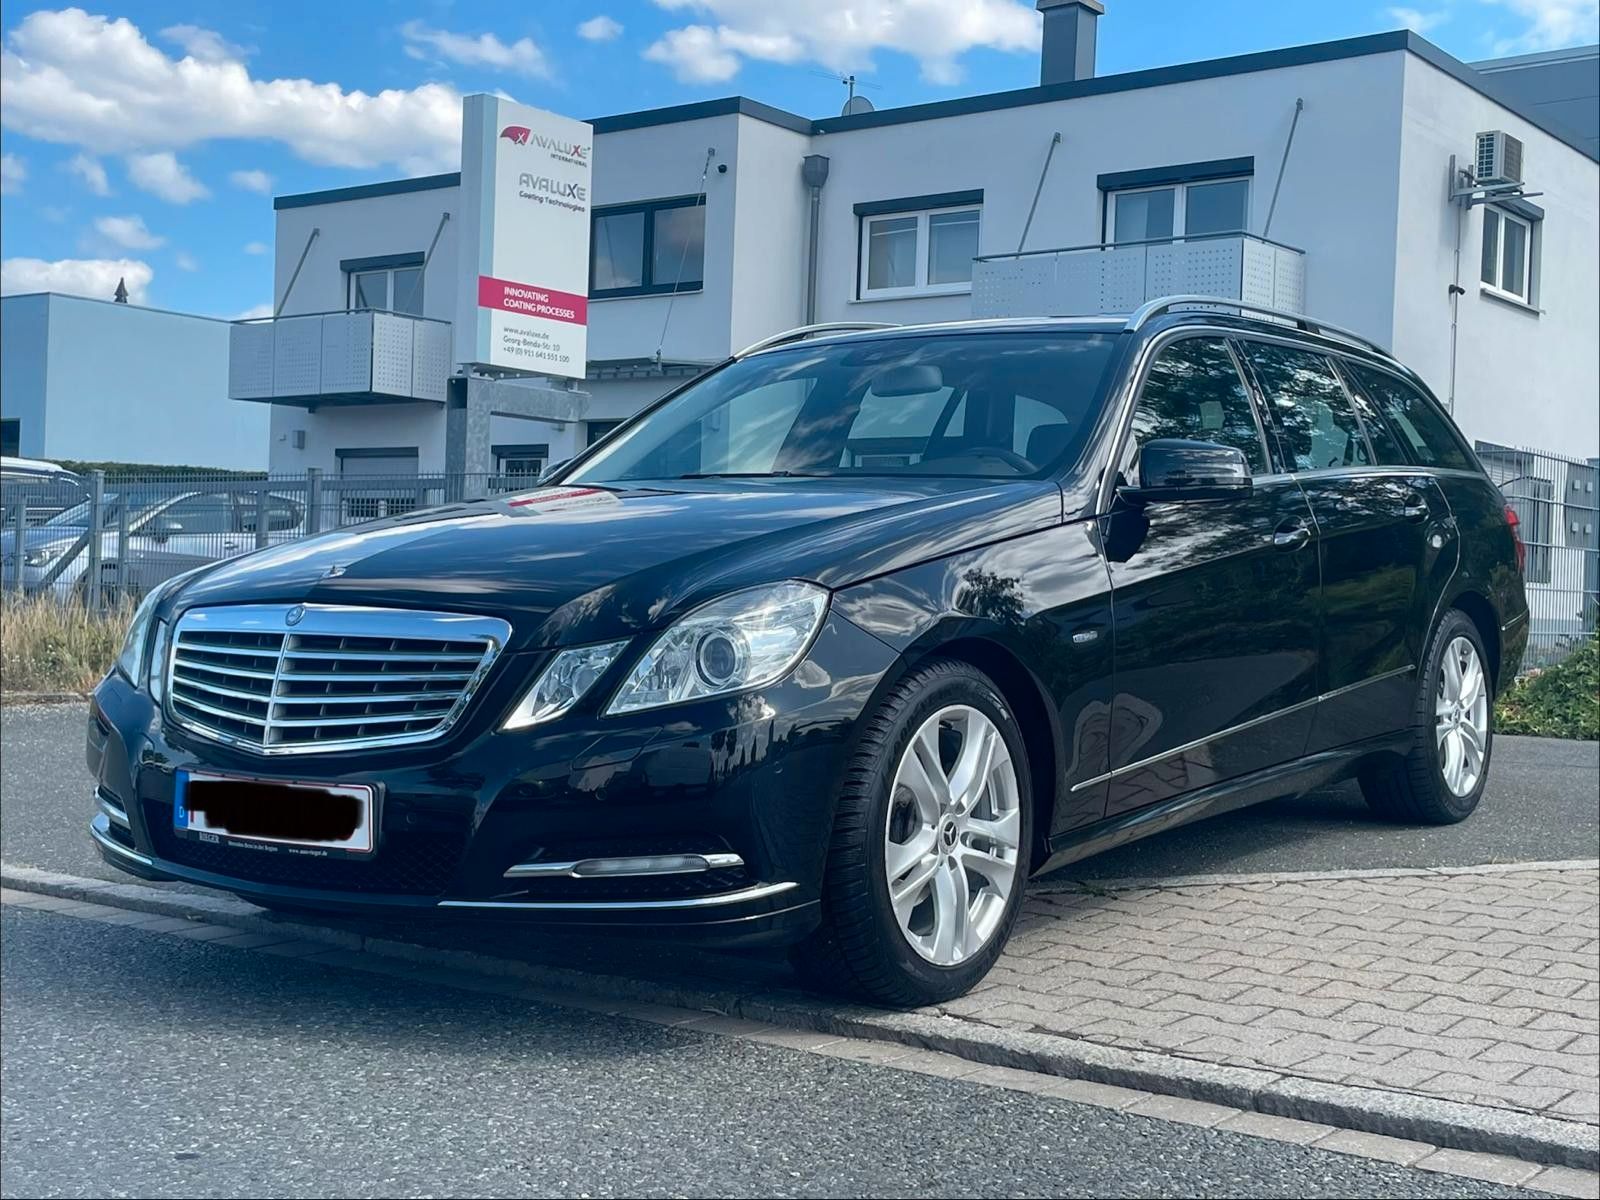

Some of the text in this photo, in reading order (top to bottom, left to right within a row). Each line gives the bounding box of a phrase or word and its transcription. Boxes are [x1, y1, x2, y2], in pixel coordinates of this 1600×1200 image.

[551, 153, 587, 167] INTERNATIONAL
[519, 173, 586, 201] AVALUXE
[519, 190, 586, 212] Coating Technologies
[504, 286, 549, 303] INNOVATING
[504, 298, 575, 318] COATING PROCESSES
[503, 327, 549, 340] www.avaluxe.de
[503, 346, 514, 354] +49
[515, 347, 523, 356] (0)
[524, 349, 535, 358] 911
[535, 351, 547, 360] 641
[552, 343, 561, 353] 10
[179, 806, 185, 818] D
